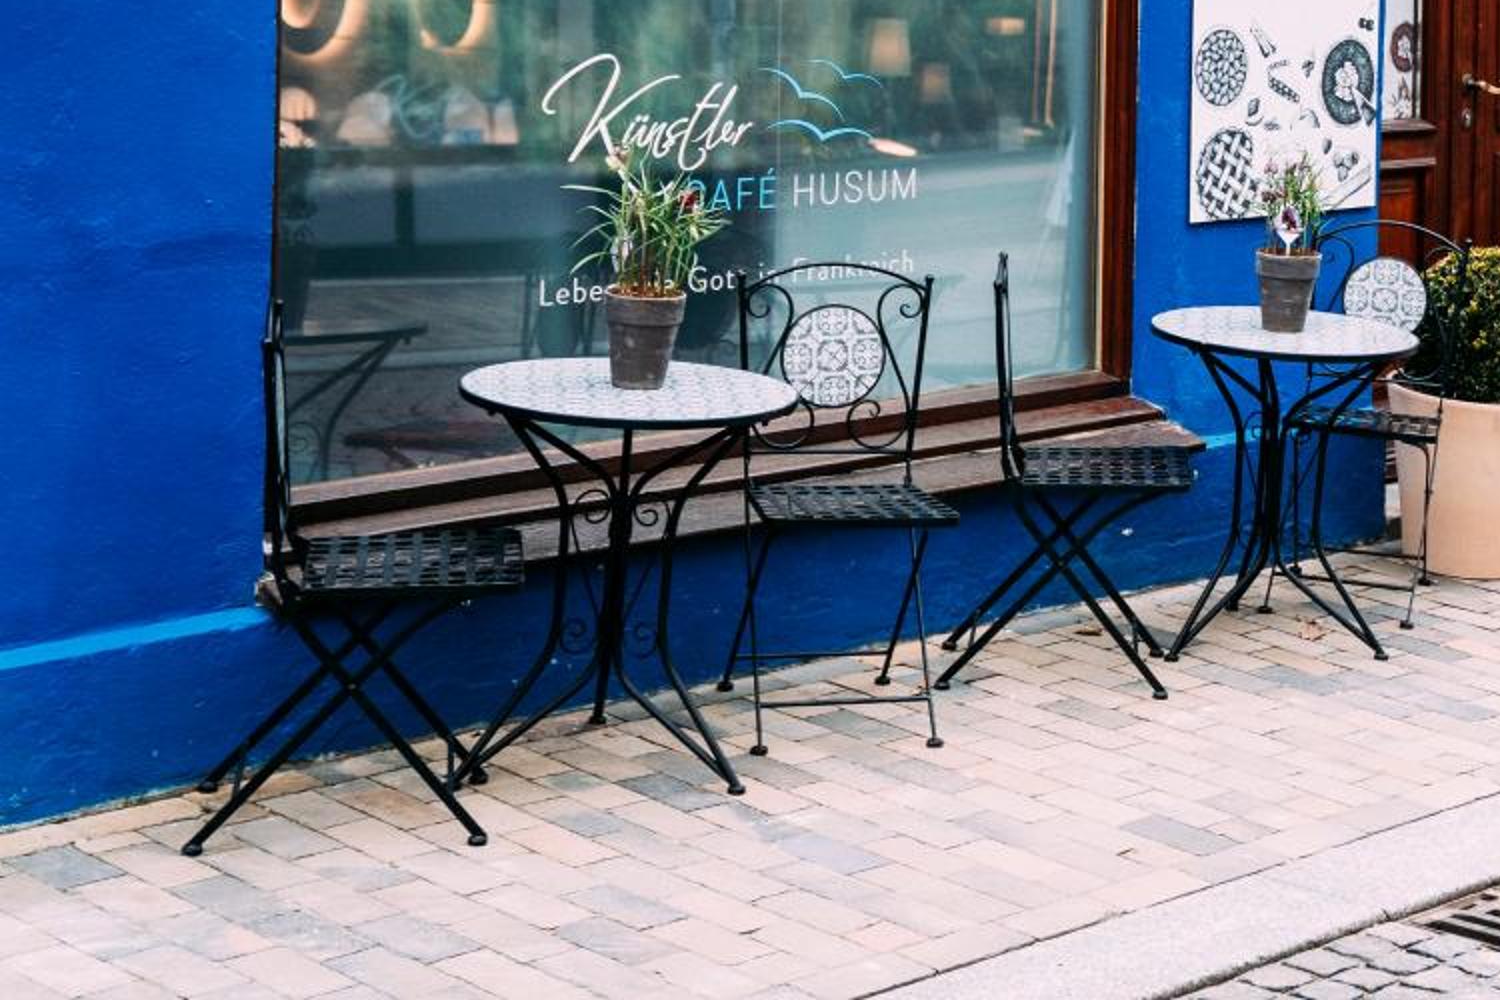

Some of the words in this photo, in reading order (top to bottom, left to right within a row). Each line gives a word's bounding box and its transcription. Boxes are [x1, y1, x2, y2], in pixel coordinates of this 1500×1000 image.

[541, 52, 756, 194] Künstler
[793, 167, 919, 209] HUSUM
[539, 277, 608, 307] Lebe
